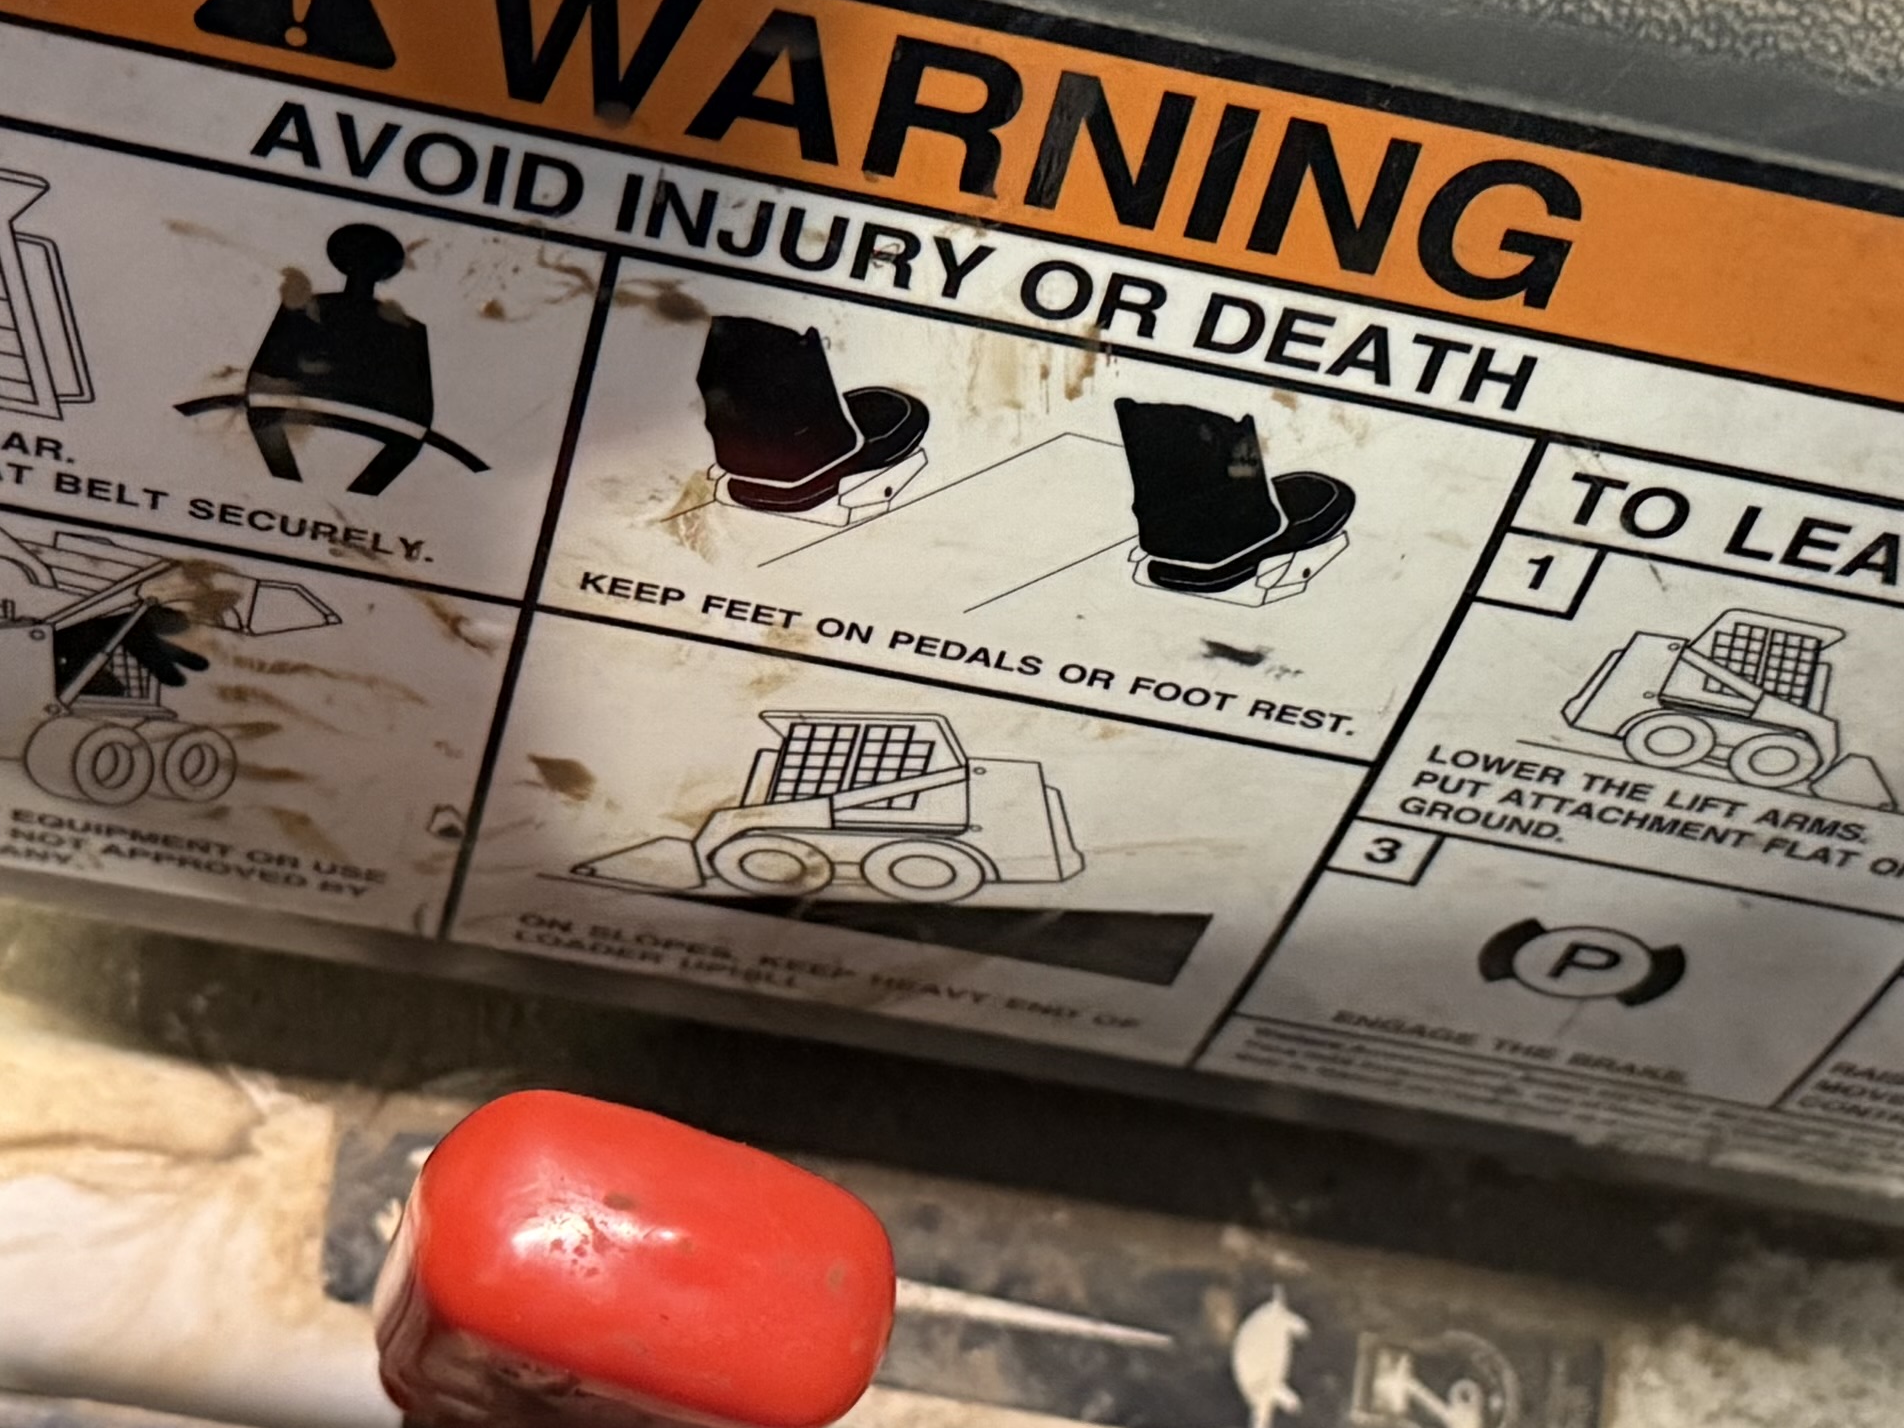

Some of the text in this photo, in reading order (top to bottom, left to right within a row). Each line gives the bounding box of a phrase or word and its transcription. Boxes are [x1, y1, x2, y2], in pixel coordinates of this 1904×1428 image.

[250, 102, 1540, 413] AVOID INJURY OR DEATH
[54, 472, 170, 511] BELT
[188, 498, 434, 564] SECURELY.
[1569, 473, 1688, 541] TO
[1526, 554, 1555, 590] 1
[579, 571, 1357, 738] KEEP FEET ON PEDALS OR FOOT REST.
[1399, 796, 1564, 843] GROUND.
[1412, 770, 1492, 798] PUT
[1498, 788, 1754, 848] ATTACHMENT
[1762, 837, 1862, 868] FLAT
[1427, 744, 1869, 844] LOWER THE LIFT ARMS.
[9, 827, 87, 851] NOT
[100, 843, 308, 887] APPROVED
[318, 879, 369, 898] BY
[10, 808, 234, 857] EQUIPMENT
[247, 849, 300, 869] OR
[313, 859, 387, 884] USE
[1363, 837, 1402, 866] 3
[514, 929, 663, 964] LOADER
[519, 912, 573, 933] ON
[758, 955, 856, 977] KEEP
[869, 973, 990, 1005] HEAVY
[1005, 996, 1079, 1019] END
[1546, 943, 1622, 980] P
[1331, 1010, 1480, 1047] ENGAGE
[1494, 1038, 1559, 1061] THE
